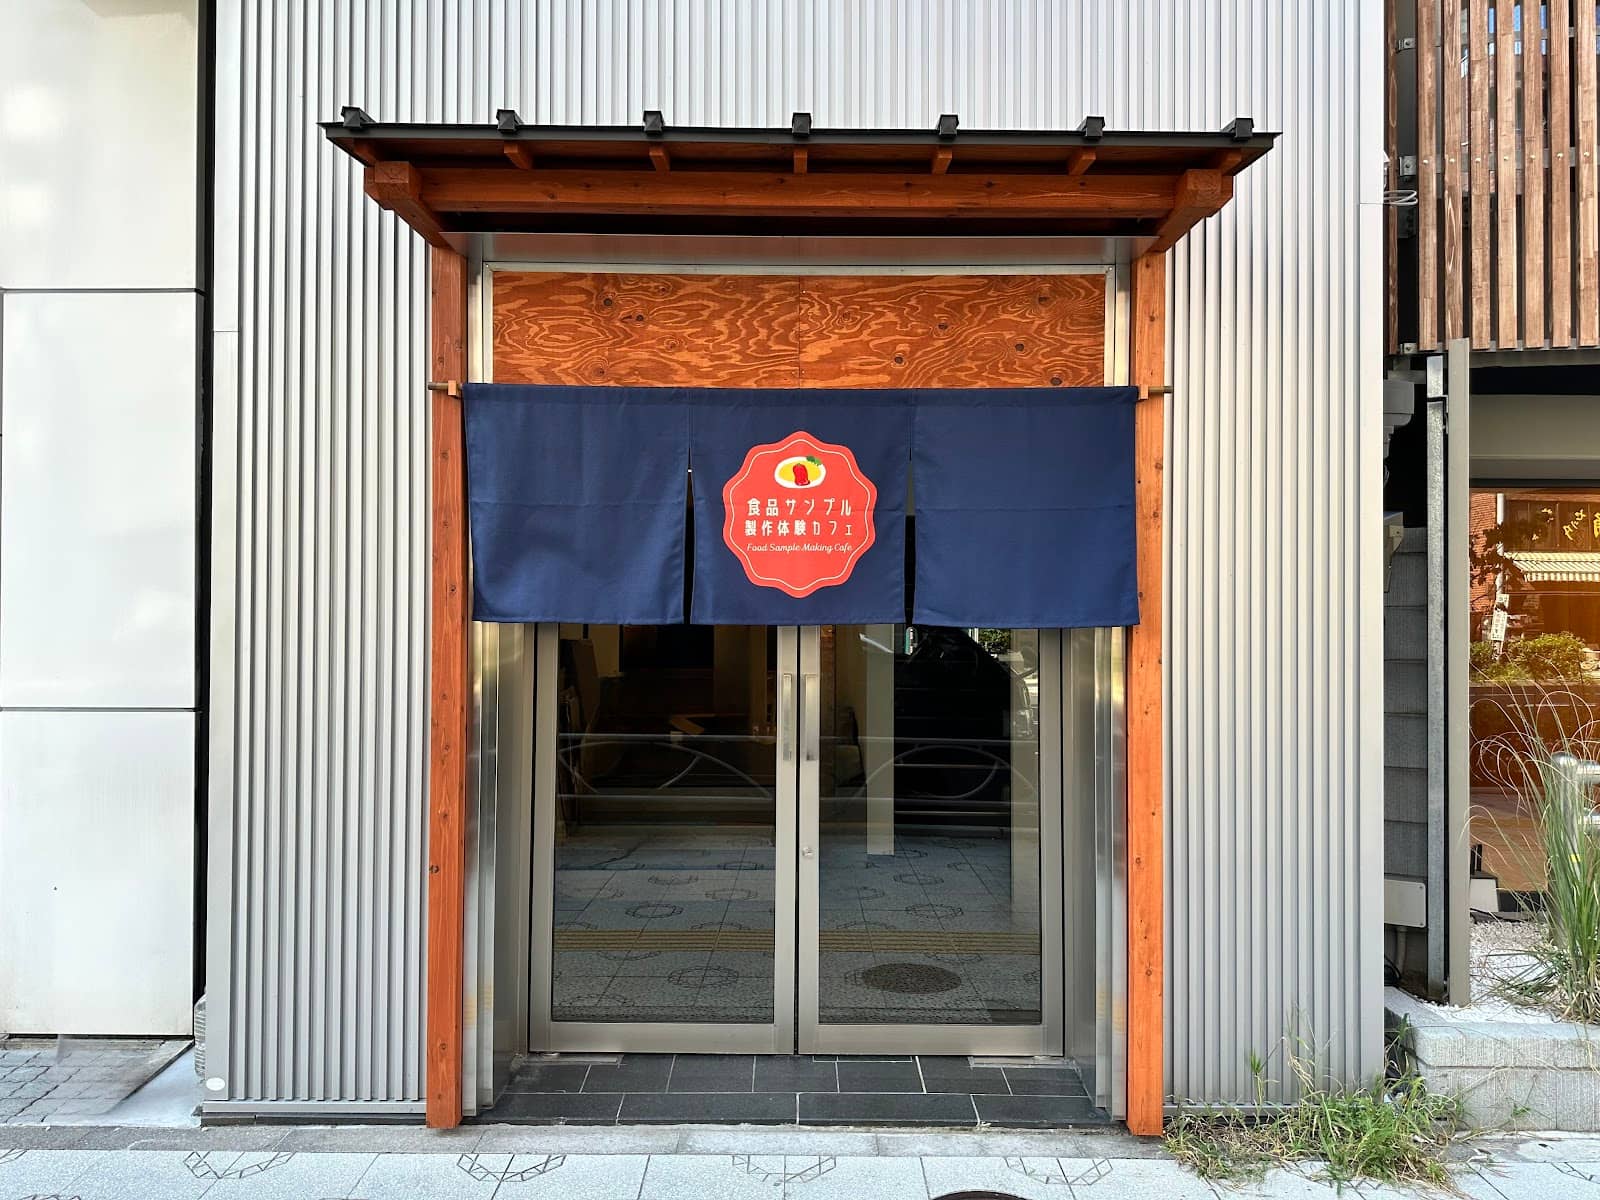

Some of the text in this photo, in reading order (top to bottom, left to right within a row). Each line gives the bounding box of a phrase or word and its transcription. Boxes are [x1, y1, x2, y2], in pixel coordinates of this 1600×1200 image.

[747, 497, 852, 516] 食品サンプル
[745, 519, 852, 536] 製作体験カフェ
[747, 542, 852, 554] Food Sample Making Cafe
